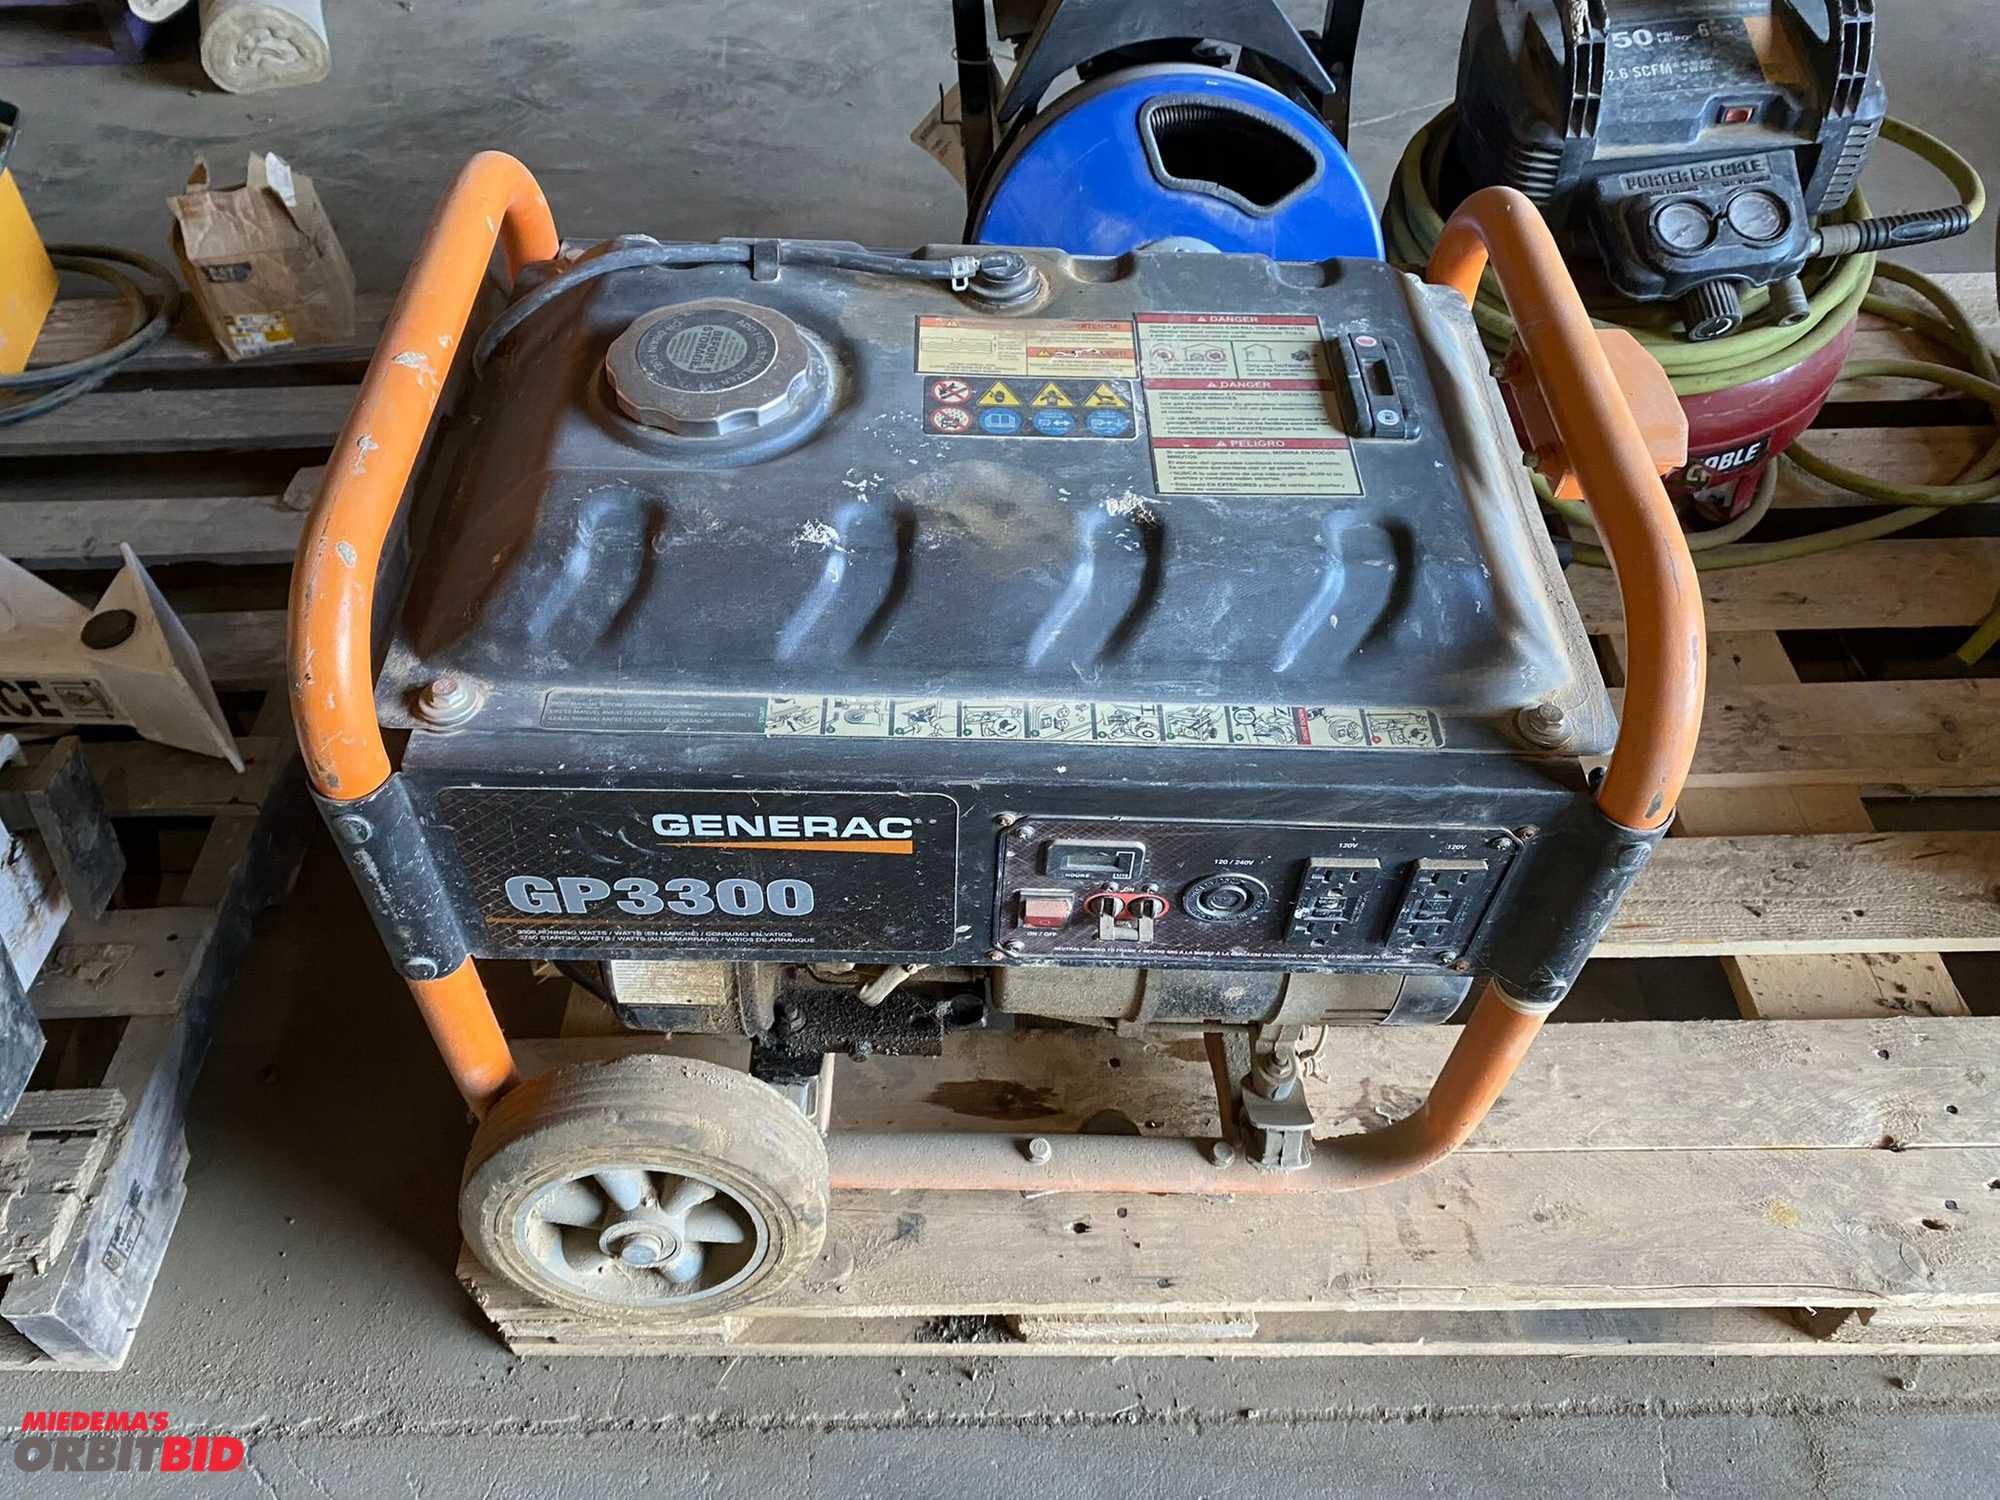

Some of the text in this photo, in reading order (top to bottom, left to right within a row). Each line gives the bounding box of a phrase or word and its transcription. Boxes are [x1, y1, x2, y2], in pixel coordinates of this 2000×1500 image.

[1631, 62, 1673, 78] SCFM
[705, 330, 725, 366] BEFORE
[1219, 381, 1272, 389] DANGER
[1230, 439, 1286, 447] PELIGRO
[1701, 443, 1761, 471] ABLE
[0, 680, 63, 718] CE
[652, 813, 914, 839] GENERAC
[504, 875, 815, 916] GP3300
